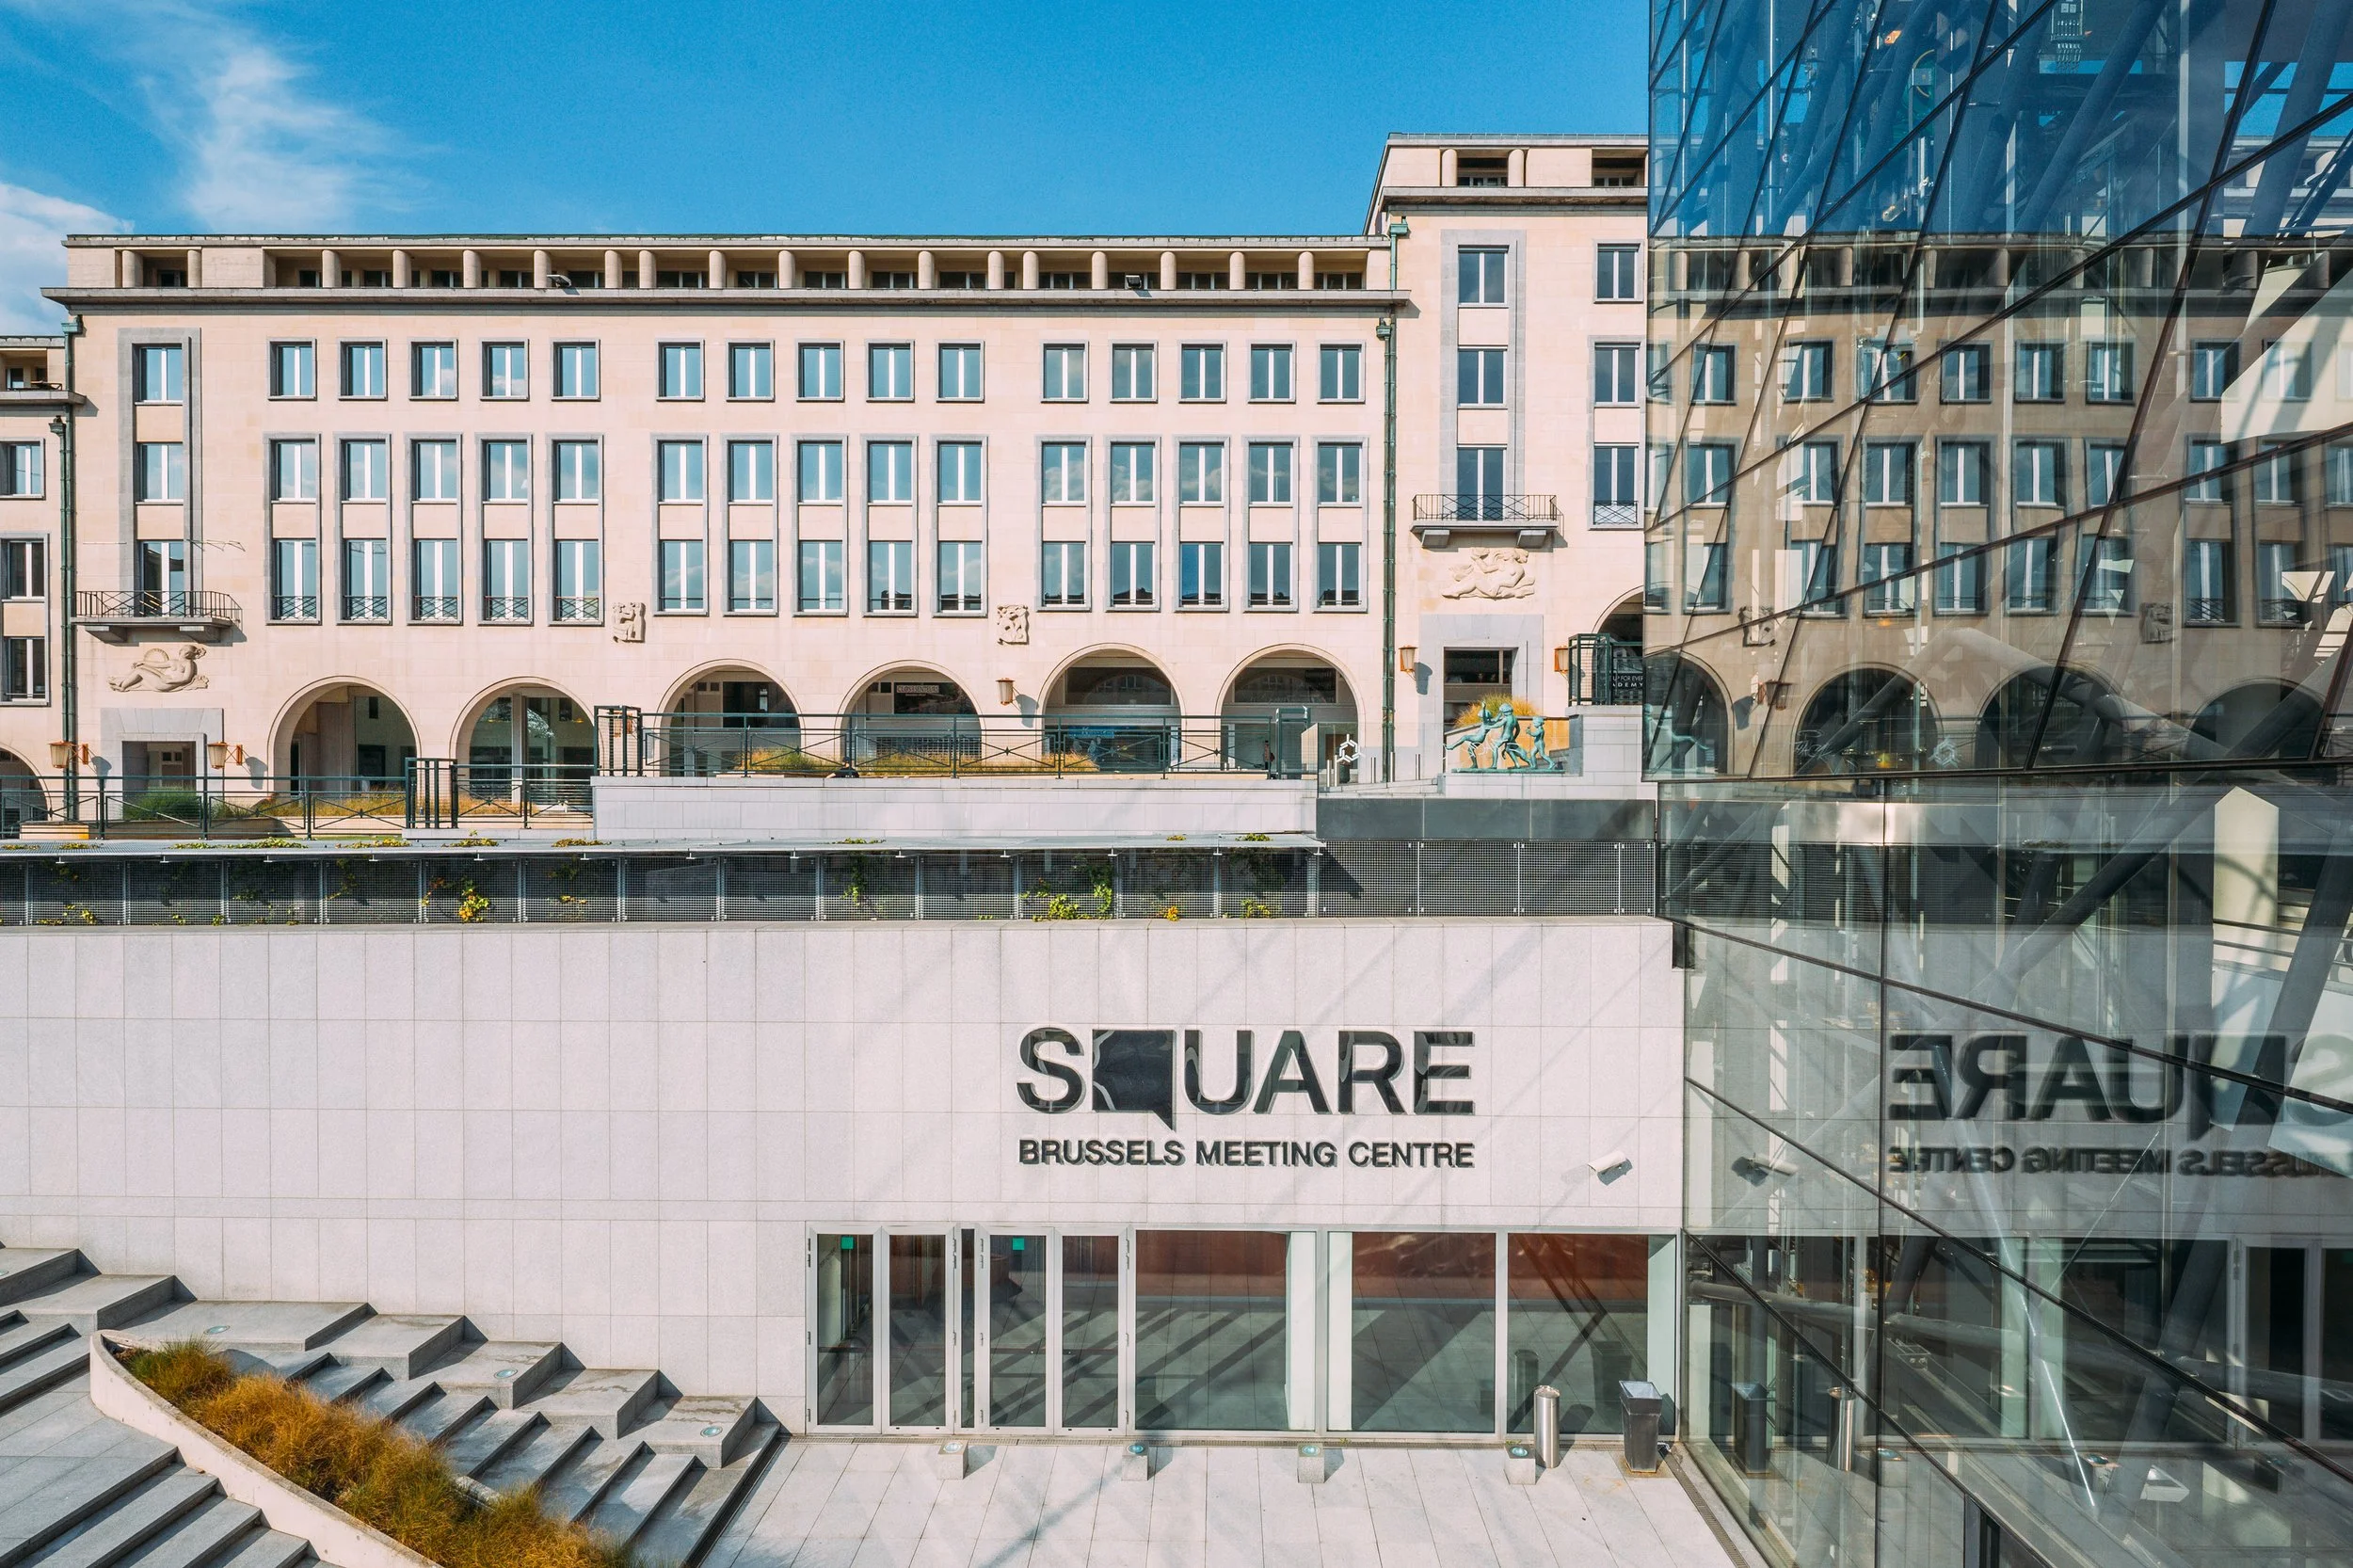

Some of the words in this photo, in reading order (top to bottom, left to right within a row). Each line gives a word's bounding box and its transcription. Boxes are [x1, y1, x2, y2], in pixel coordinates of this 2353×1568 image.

[1016, 1027, 1475, 1131] SQUARE
[1018, 1138, 1185, 1166] BRUSSELS
[1195, 1139, 1337, 1167] MEETING
[1348, 1141, 1475, 1167] CENTRE
